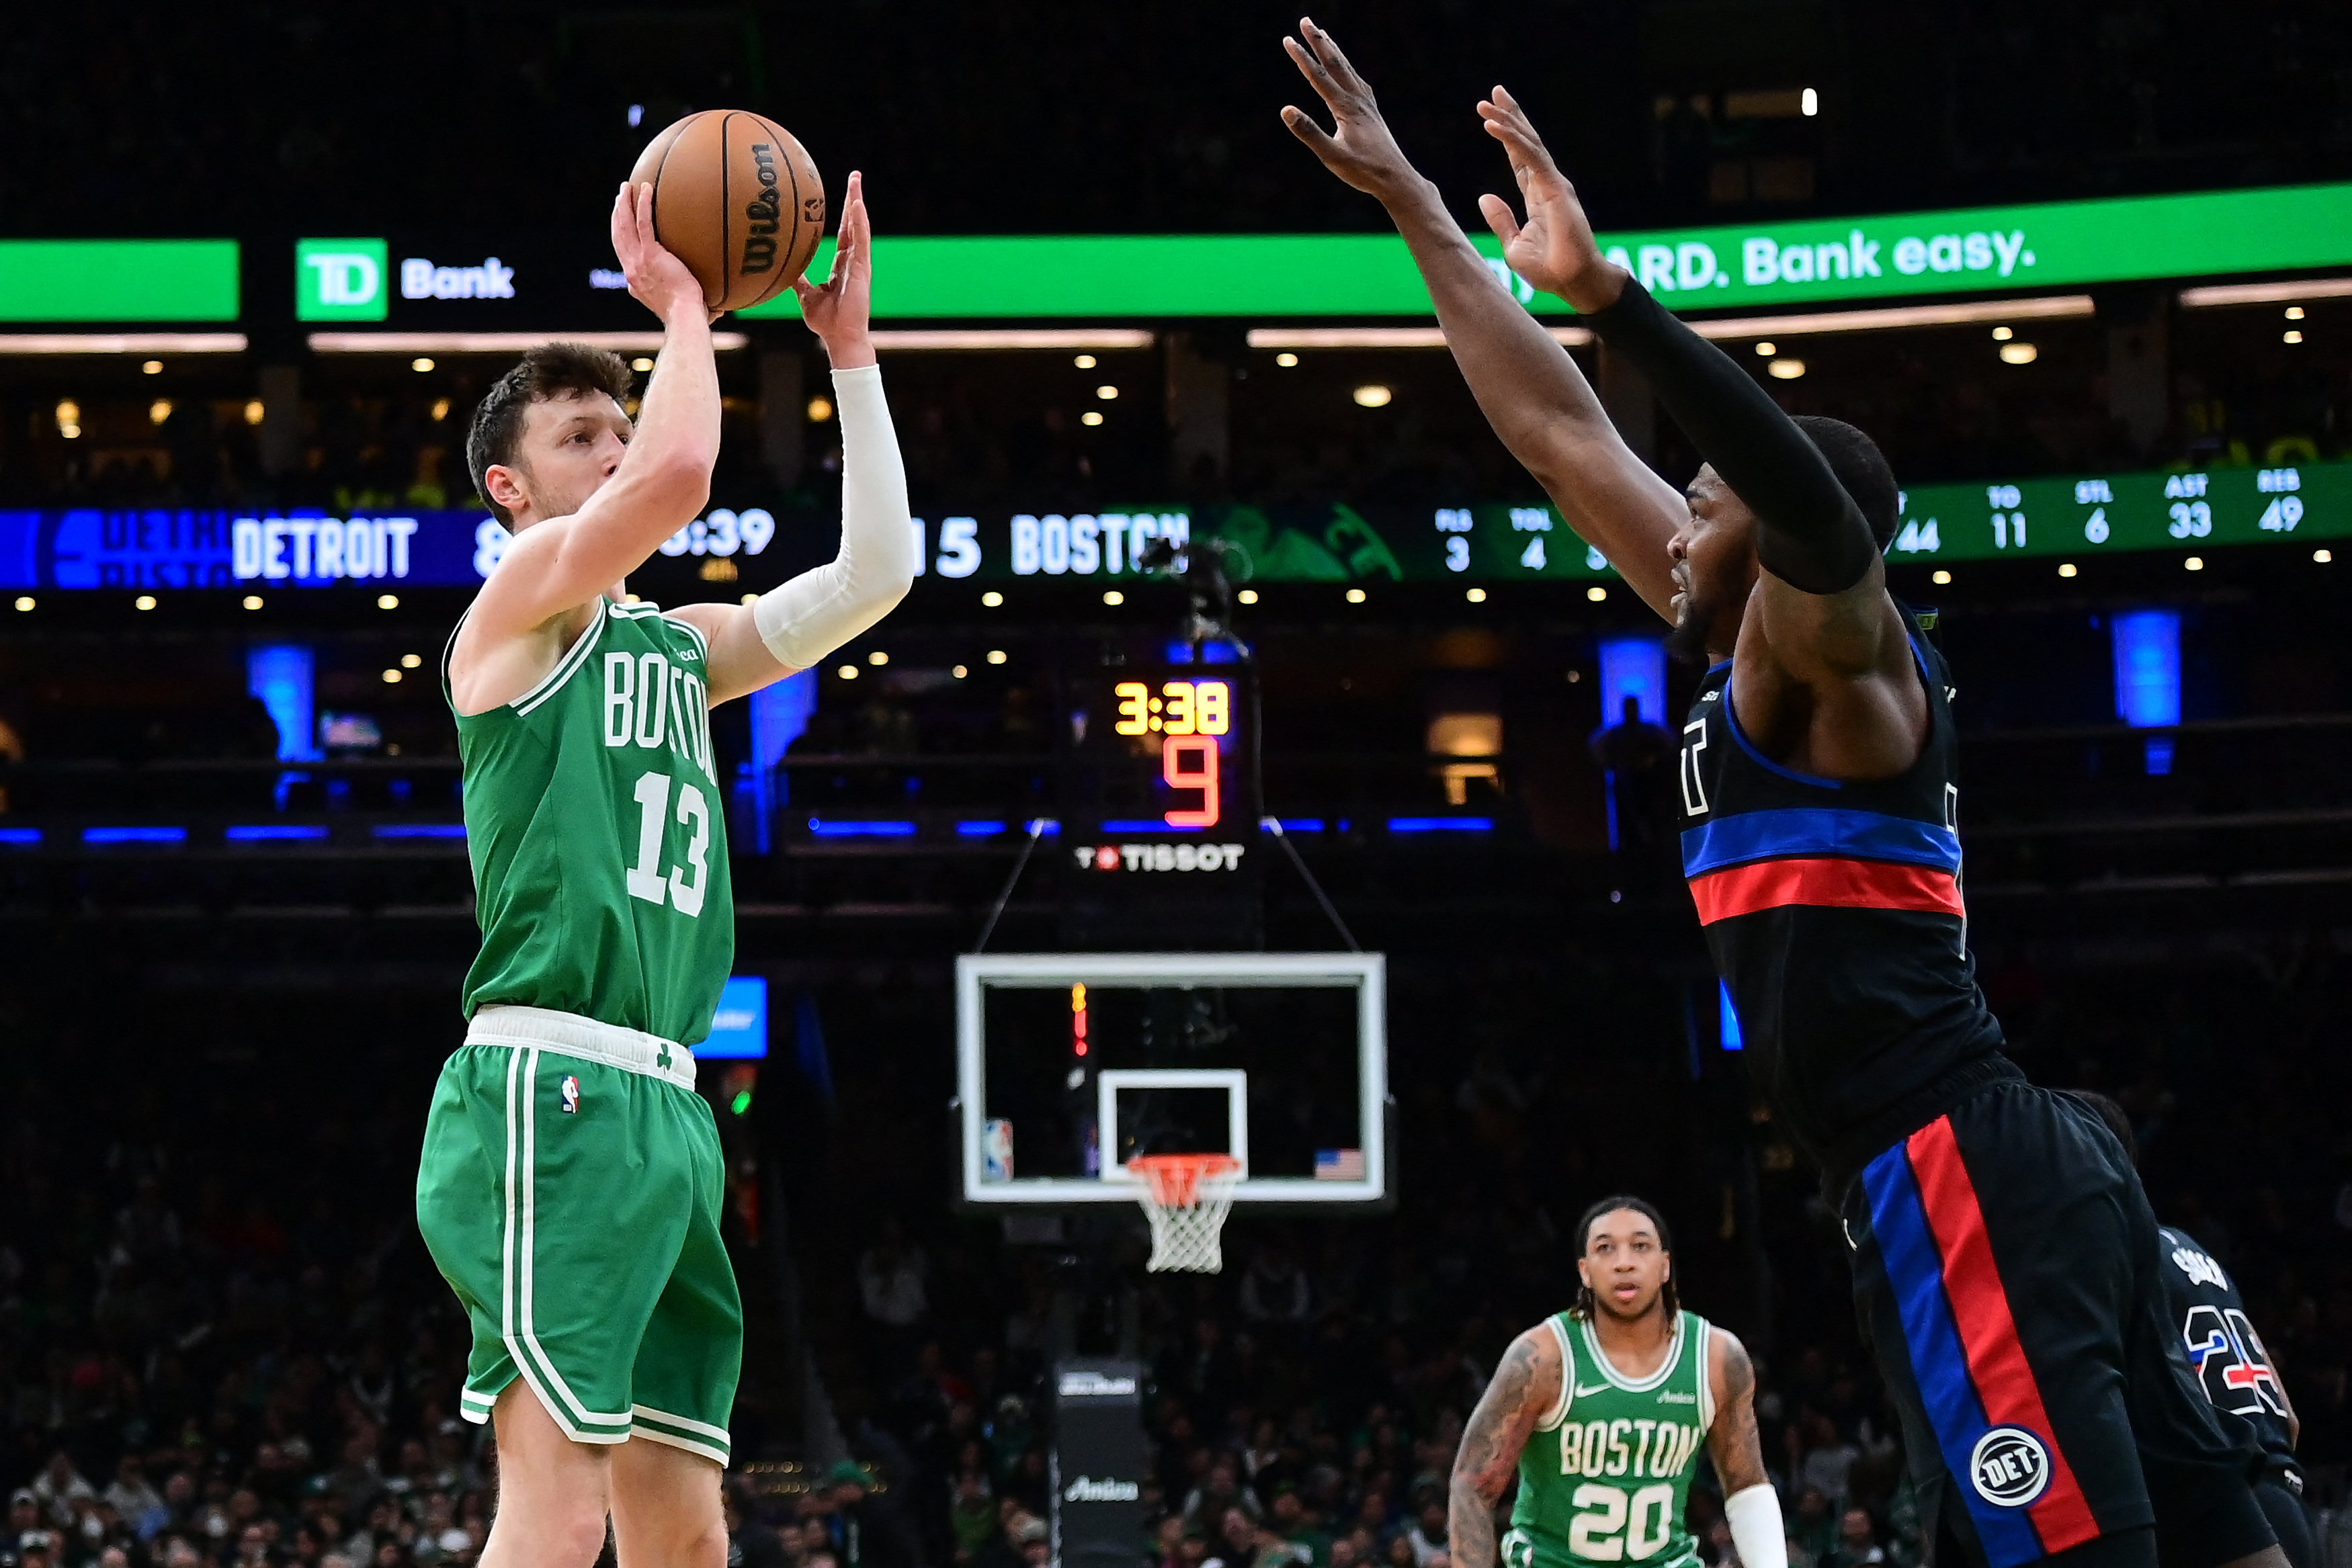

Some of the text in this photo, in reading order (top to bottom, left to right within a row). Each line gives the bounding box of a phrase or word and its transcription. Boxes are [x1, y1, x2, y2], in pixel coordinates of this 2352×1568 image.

[741, 143, 781, 275] Wilson
[306, 253, 515, 304] TD Bank
[1605, 230, 2037, 293] ARD. Bank easy.
[232, 517, 419, 580] DETROIT
[1990, 511, 2027, 550] 11
[2085, 507, 2110, 545] 6
[2168, 500, 2213, 539] 33
[2258, 495, 2304, 533] 49
[1445, 535, 1471, 572] 3
[1520, 535, 1547, 570] 4
[1114, 681, 1230, 736] 3:38
[1163, 734, 1220, 828] 9
[626, 771, 710, 919] 13
[1120, 842, 1246, 872] TISSOT
[1560, 1418, 1701, 1478] BOSTON
[1981, 1446, 2038, 1489] DET
[1568, 1482, 1674, 1562] 20
